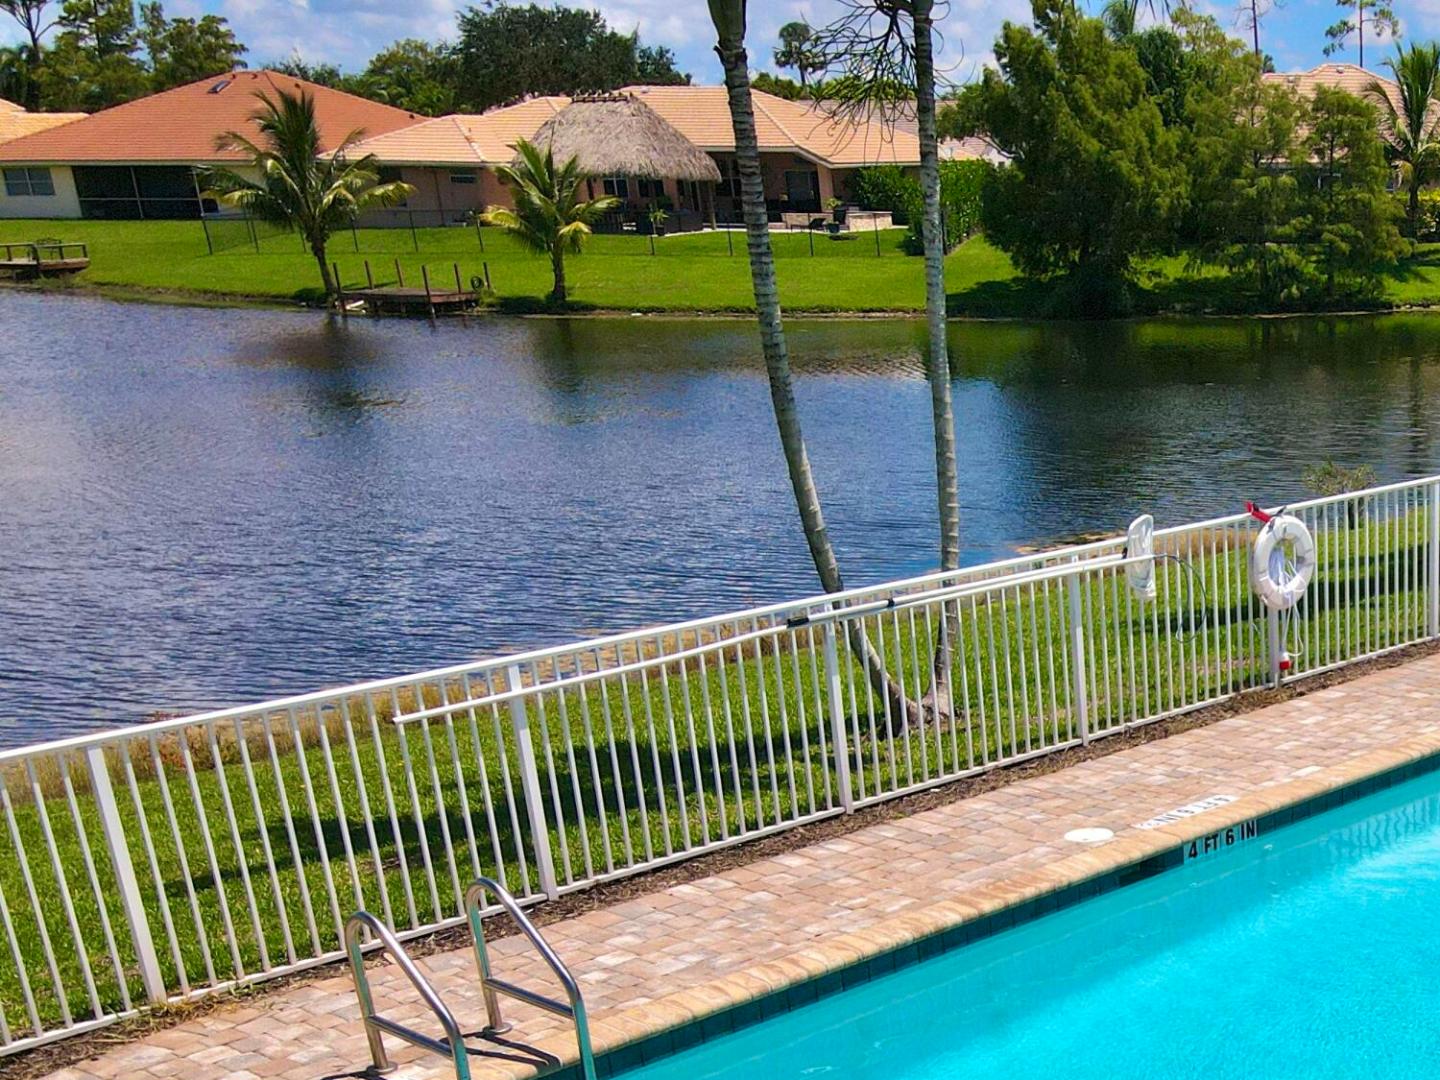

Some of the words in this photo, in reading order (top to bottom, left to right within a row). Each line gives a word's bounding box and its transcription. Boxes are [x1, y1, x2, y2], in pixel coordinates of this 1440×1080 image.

[1188, 842, 1198, 858] 4
[1204, 832, 1219, 854] FT
[1225, 828, 1235, 846] 6
[1240, 820, 1255, 840] IN
